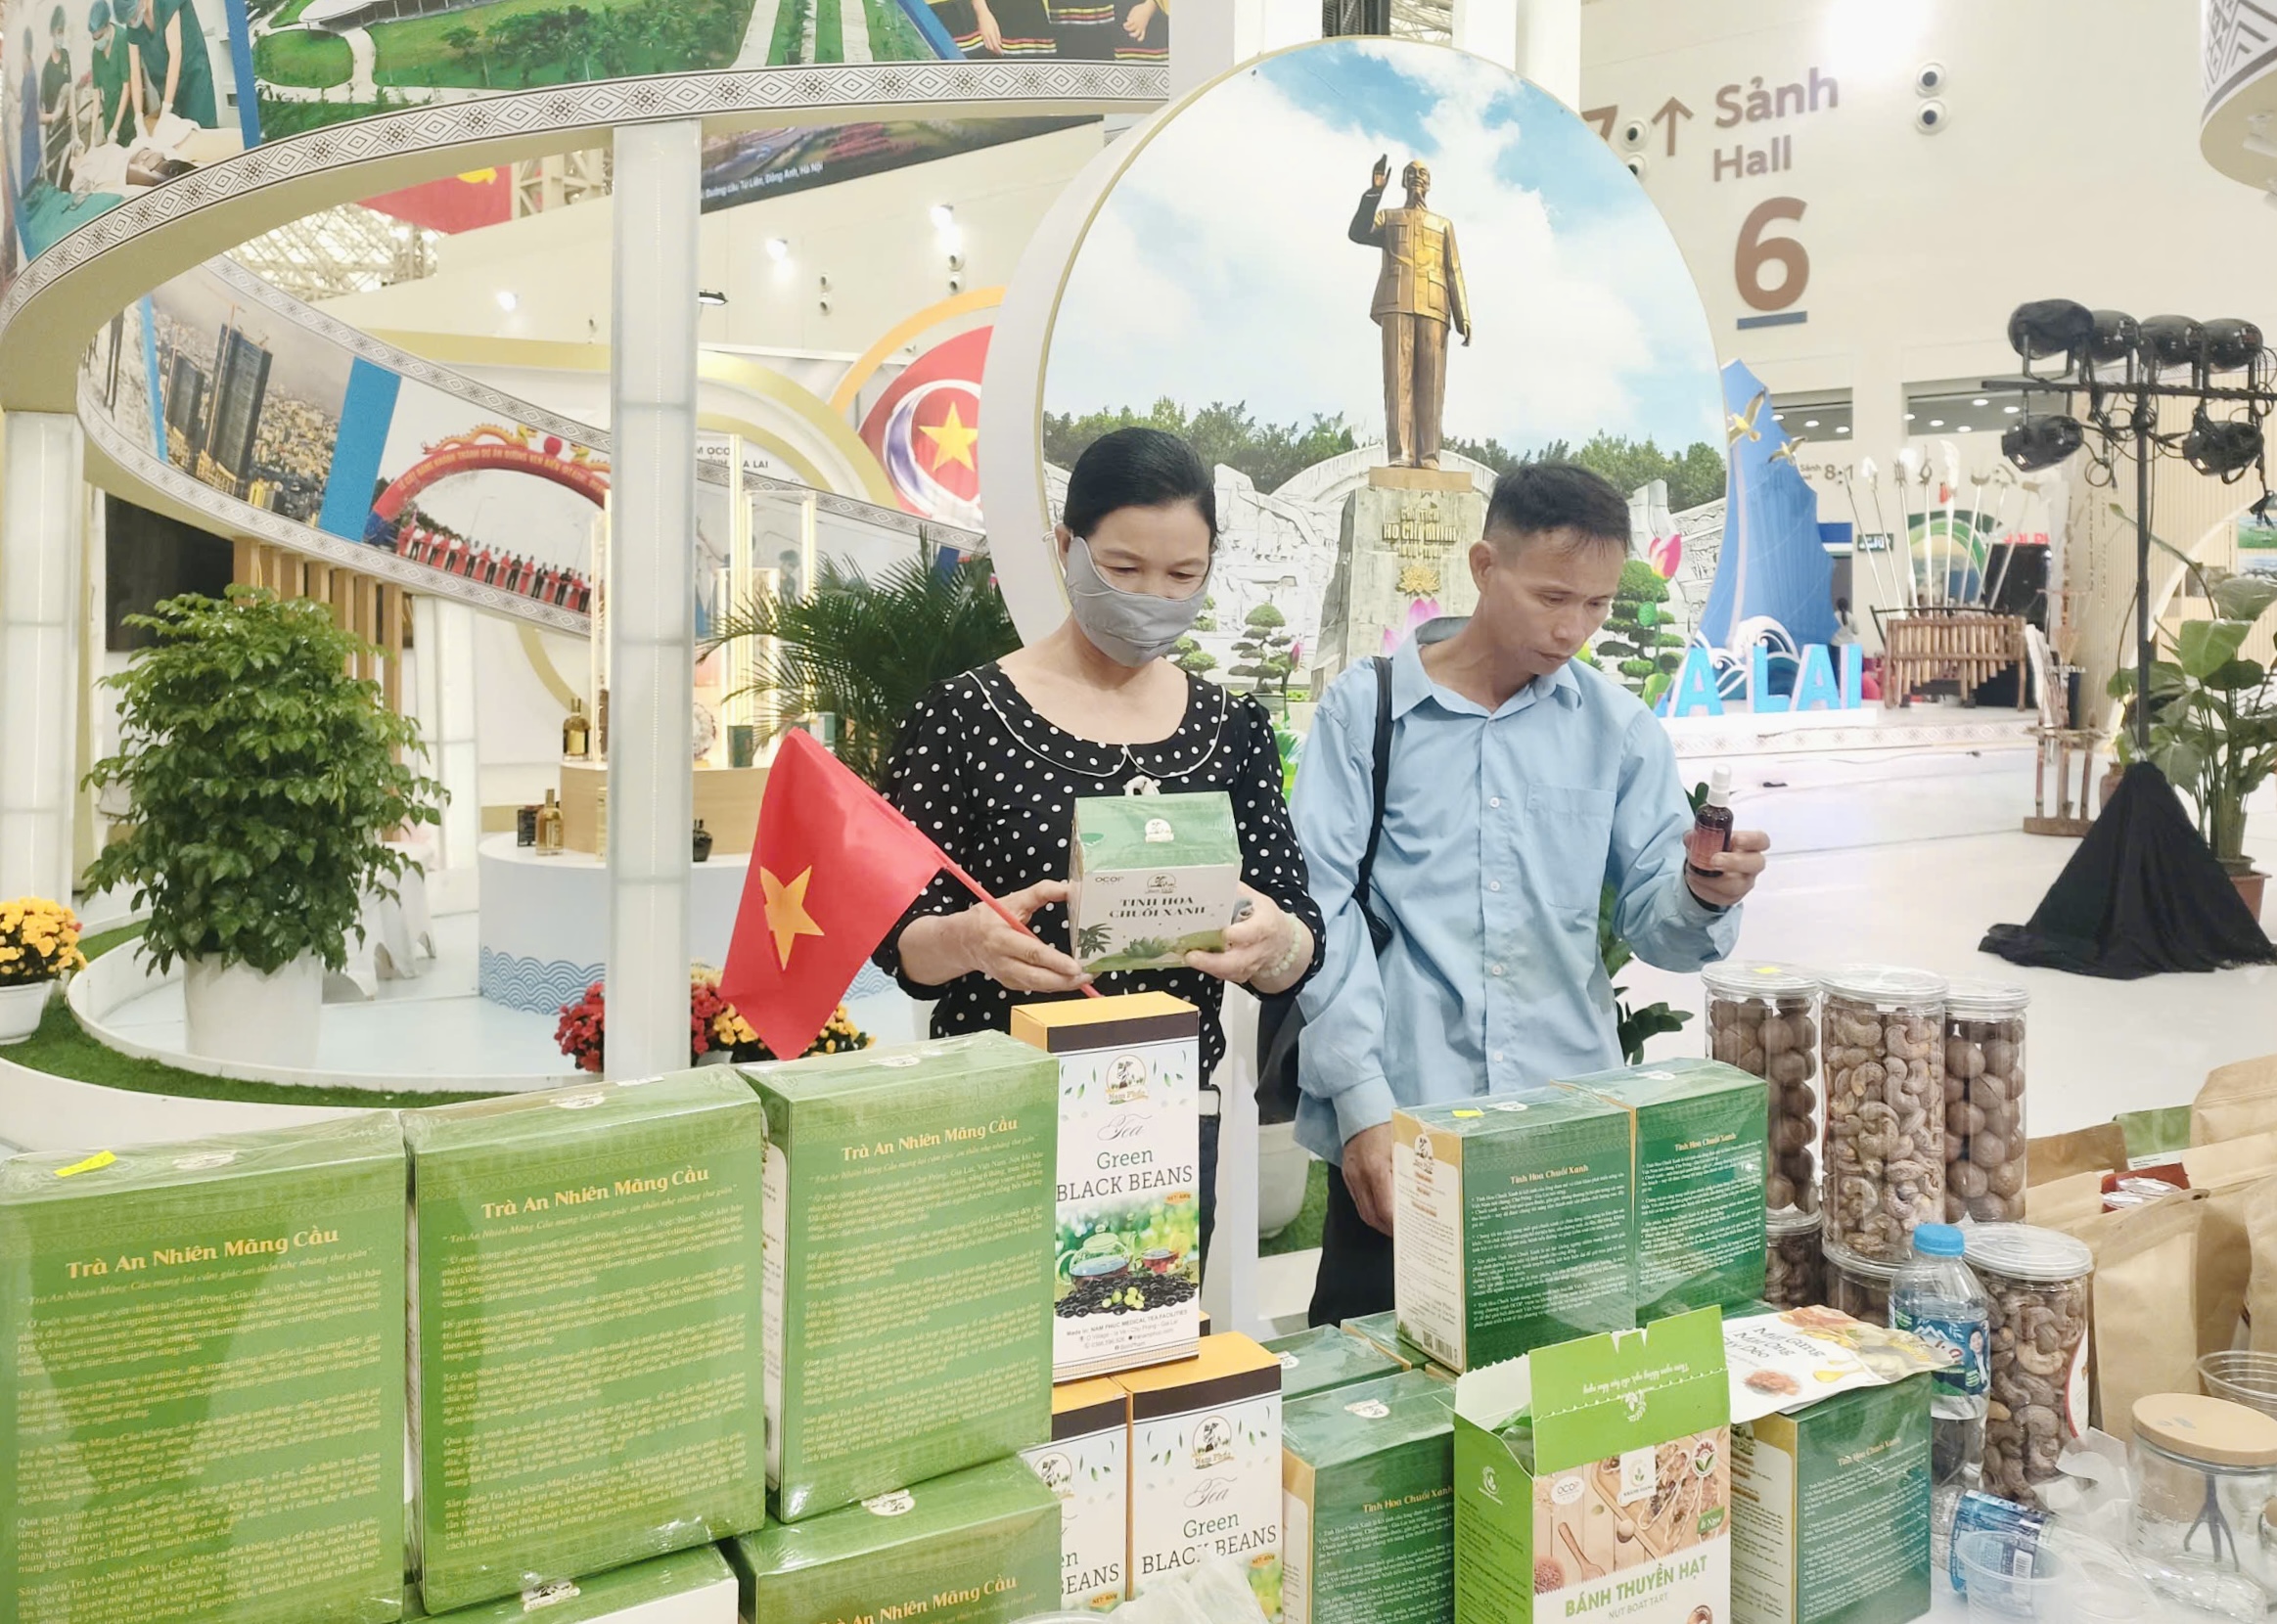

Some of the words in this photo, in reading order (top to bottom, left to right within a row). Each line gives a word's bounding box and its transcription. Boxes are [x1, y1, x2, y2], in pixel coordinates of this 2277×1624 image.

[1715, 67, 1839, 129] Sảnh
[1713, 135, 1792, 182] Hall
[1735, 197, 1809, 311] 6
[1824, 464, 1837, 480] 8
[1747, 644, 1863, 714] LAI
[1161, 895, 1194, 906] HOA
[1162, 906, 1206, 917] XANH
[842, 1143, 869, 1162] Trà
[874, 1142, 894, 1157] An
[898, 1132, 940, 1151] Nhiên
[944, 1124, 986, 1144] Mãng
[988, 1116, 1018, 1135] Cầu
[1096, 1150, 1154, 1170] Green
[481, 1199, 518, 1219] Trà
[523, 1196, 549, 1213] An
[554, 1186, 610, 1208] Nhiên
[615, 1176, 668, 1197] Mãng
[671, 1164, 709, 1186] Cầu
[1057, 1176, 1122, 1202] BLACK
[1128, 1165, 1193, 1192] BEANS
[1510, 1174, 1527, 1185] Tinh
[1528, 1172, 1544, 1182] Hoa
[1569, 1164, 1589, 1175] Xanh
[66, 1257, 108, 1280] Trà
[115, 1255, 147, 1273] An
[154, 1245, 217, 1267] Nhiên
[224, 1238, 289, 1258] Mãng
[294, 1225, 340, 1248] Cầu
[1362, 1503, 1383, 1515] Tinh
[1385, 1498, 1402, 1511] Hoa
[1431, 1485, 1454, 1499] Xanh
[1183, 1512, 1239, 1539] Green
[1142, 1543, 1209, 1575] BLAC
[1215, 1524, 1277, 1556] BEANS
[880, 1599, 929, 1622] Nhiên
[933, 1587, 980, 1611] Mãng
[983, 1574, 1018, 1594] Cầu
[1566, 1587, 1612, 1617] BÁNH
[1617, 1562, 1674, 1601] THUYỀN
[1679, 1555, 1708, 1580] HẠT
[1609, 1607, 1625, 1619] NUT
[1627, 1601, 1648, 1615] BOAT
[1649, 1593, 1668, 1606] TART
